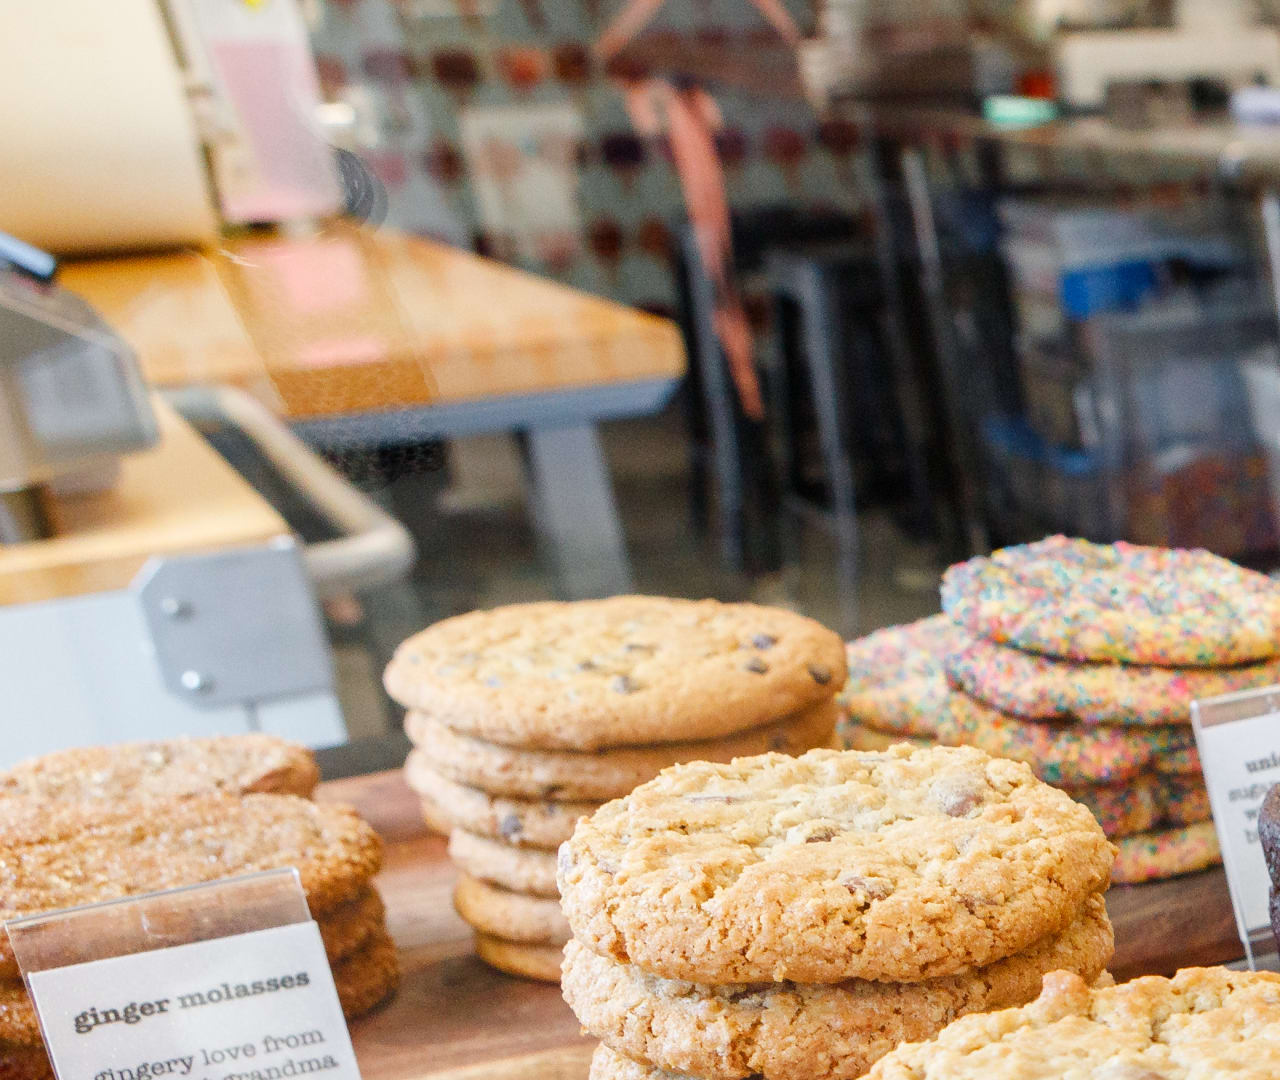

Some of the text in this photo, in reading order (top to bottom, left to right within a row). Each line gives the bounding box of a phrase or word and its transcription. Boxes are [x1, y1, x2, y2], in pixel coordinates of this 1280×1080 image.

[74, 971, 311, 1034] ginger molasses
[202, 1041, 257, 1066] love
[263, 1028, 326, 1054] from
